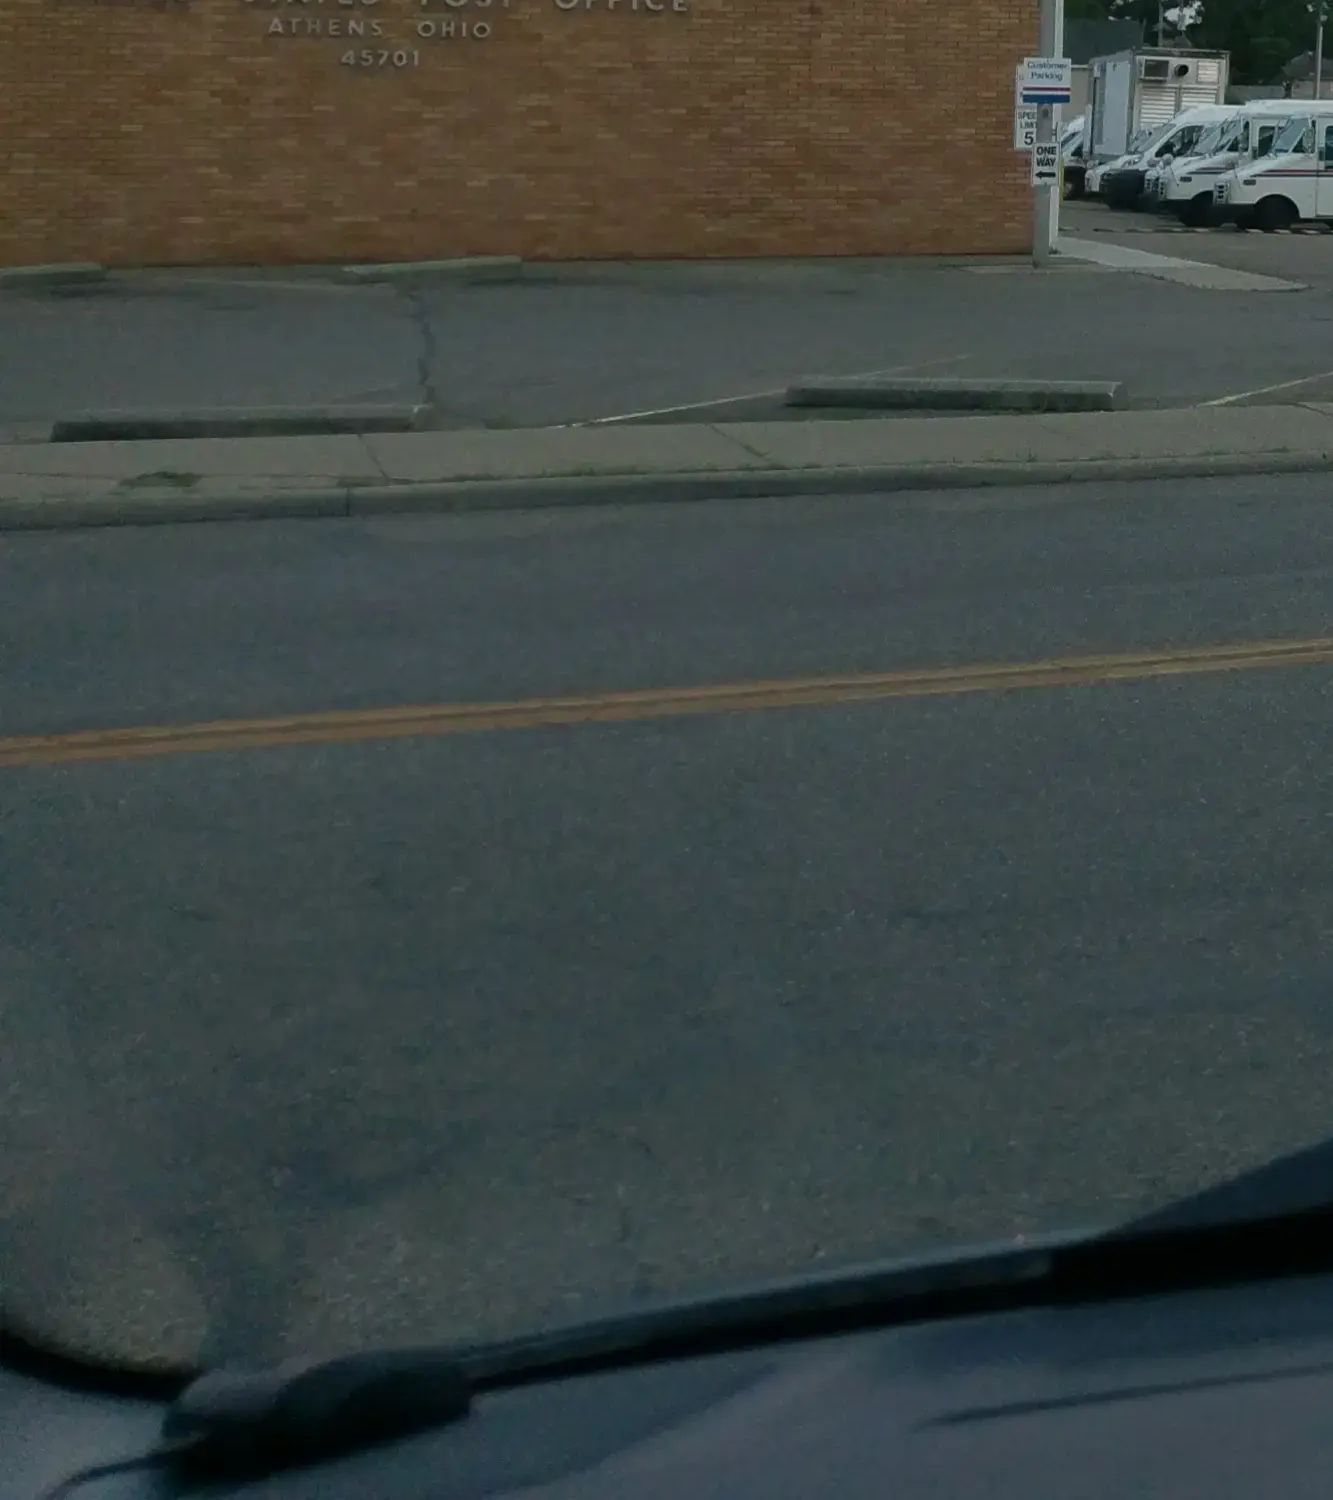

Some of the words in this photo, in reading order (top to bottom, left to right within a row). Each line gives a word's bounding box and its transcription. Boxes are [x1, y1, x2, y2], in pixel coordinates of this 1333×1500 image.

[268, 17, 384, 37] ATHENS
[417, 20, 492, 39] OHIO
[340, 49, 420, 68] 45701
[1027, 61, 1067, 69] Customer
[1031, 71, 1063, 82] Parking
[1018, 111, 1037, 120] SPEE
[1024, 131, 1034, 146] 5
[1036, 146, 1057, 156] ONE
[1036, 157, 1056, 167] WAY
